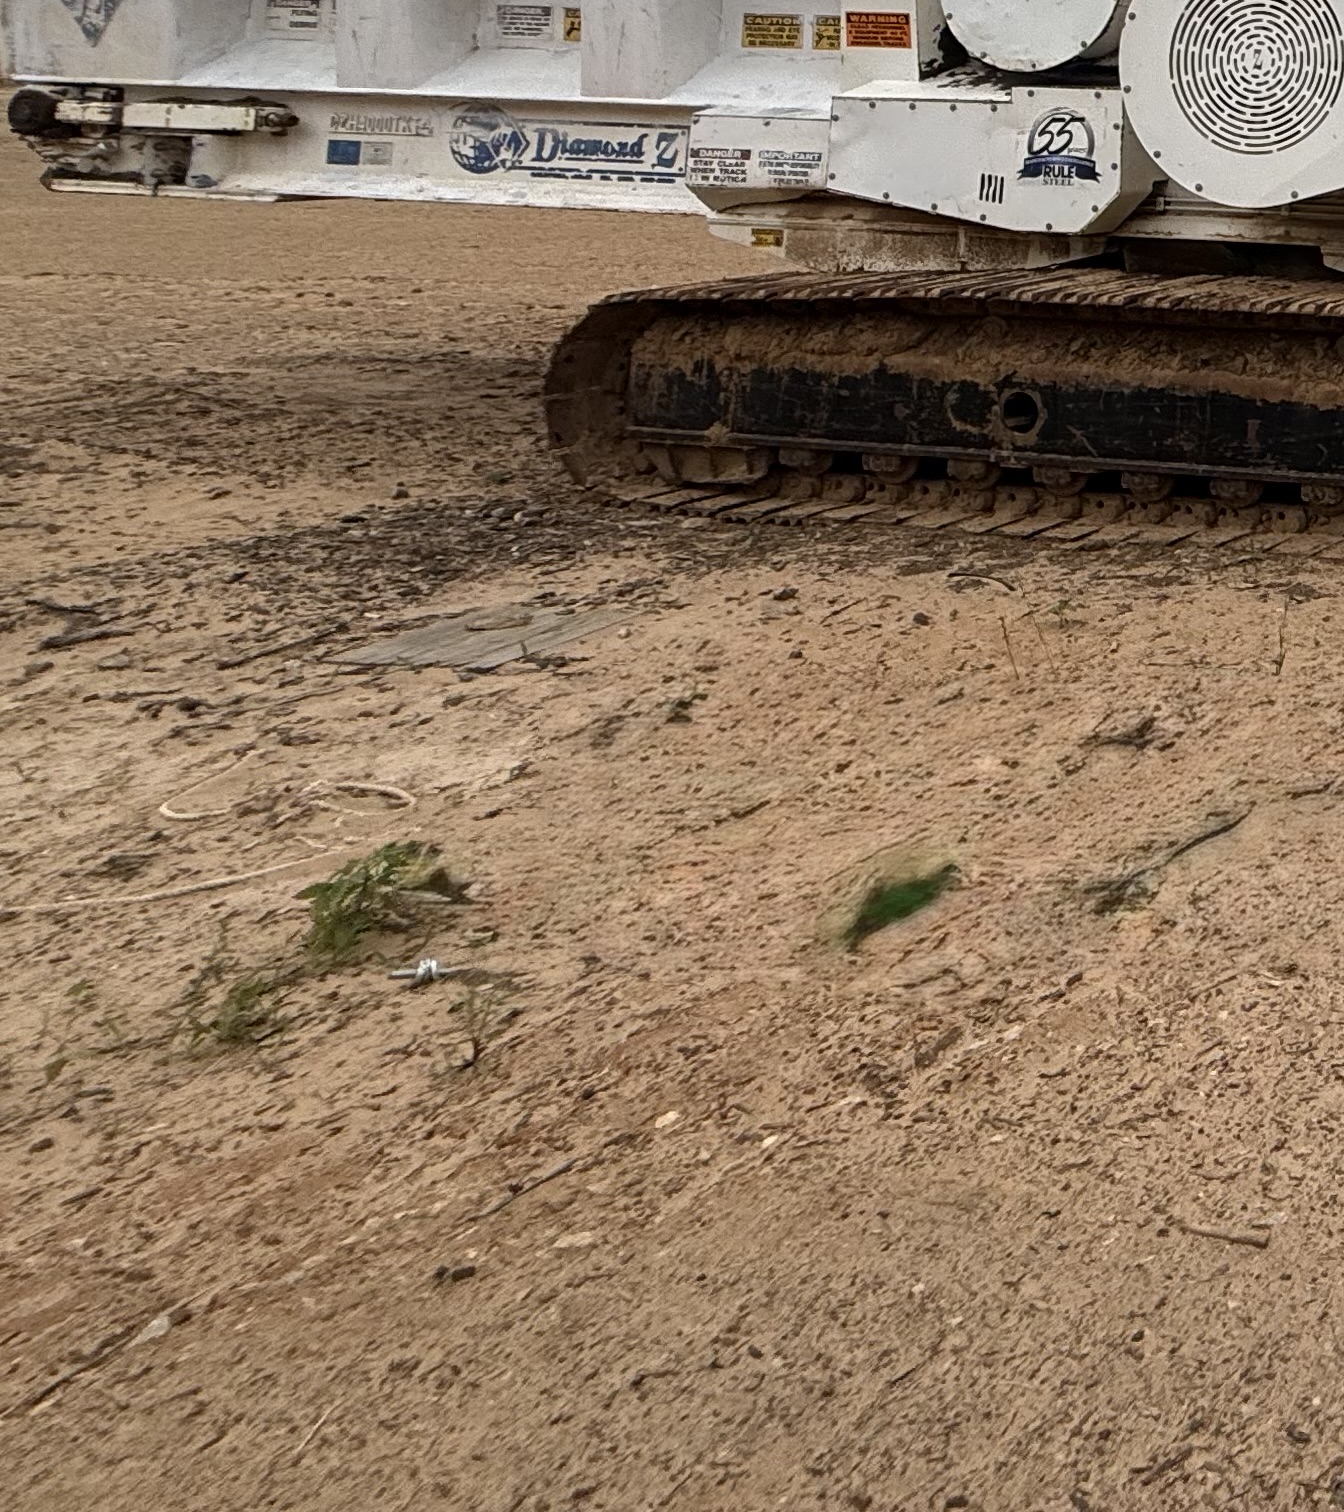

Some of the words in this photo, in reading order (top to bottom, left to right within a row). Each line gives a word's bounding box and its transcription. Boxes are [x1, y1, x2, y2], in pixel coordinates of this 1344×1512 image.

[745, 16, 801, 25] CAUTION
[848, 14, 907, 24] WARNING
[1029, 117, 1086, 155] 55
[530, 127, 650, 163] Diamond
[650, 131, 680, 169] Z
[698, 149, 742, 158] DANGER
[759, 151, 820, 161] IMPORTANT
[693, 159, 714, 167] STAY
[717, 160, 746, 168] CLEAR
[719, 168, 748, 176] TRACK
[1043, 165, 1075, 179] RULE
[1042, 178, 1075, 186] STEEL
